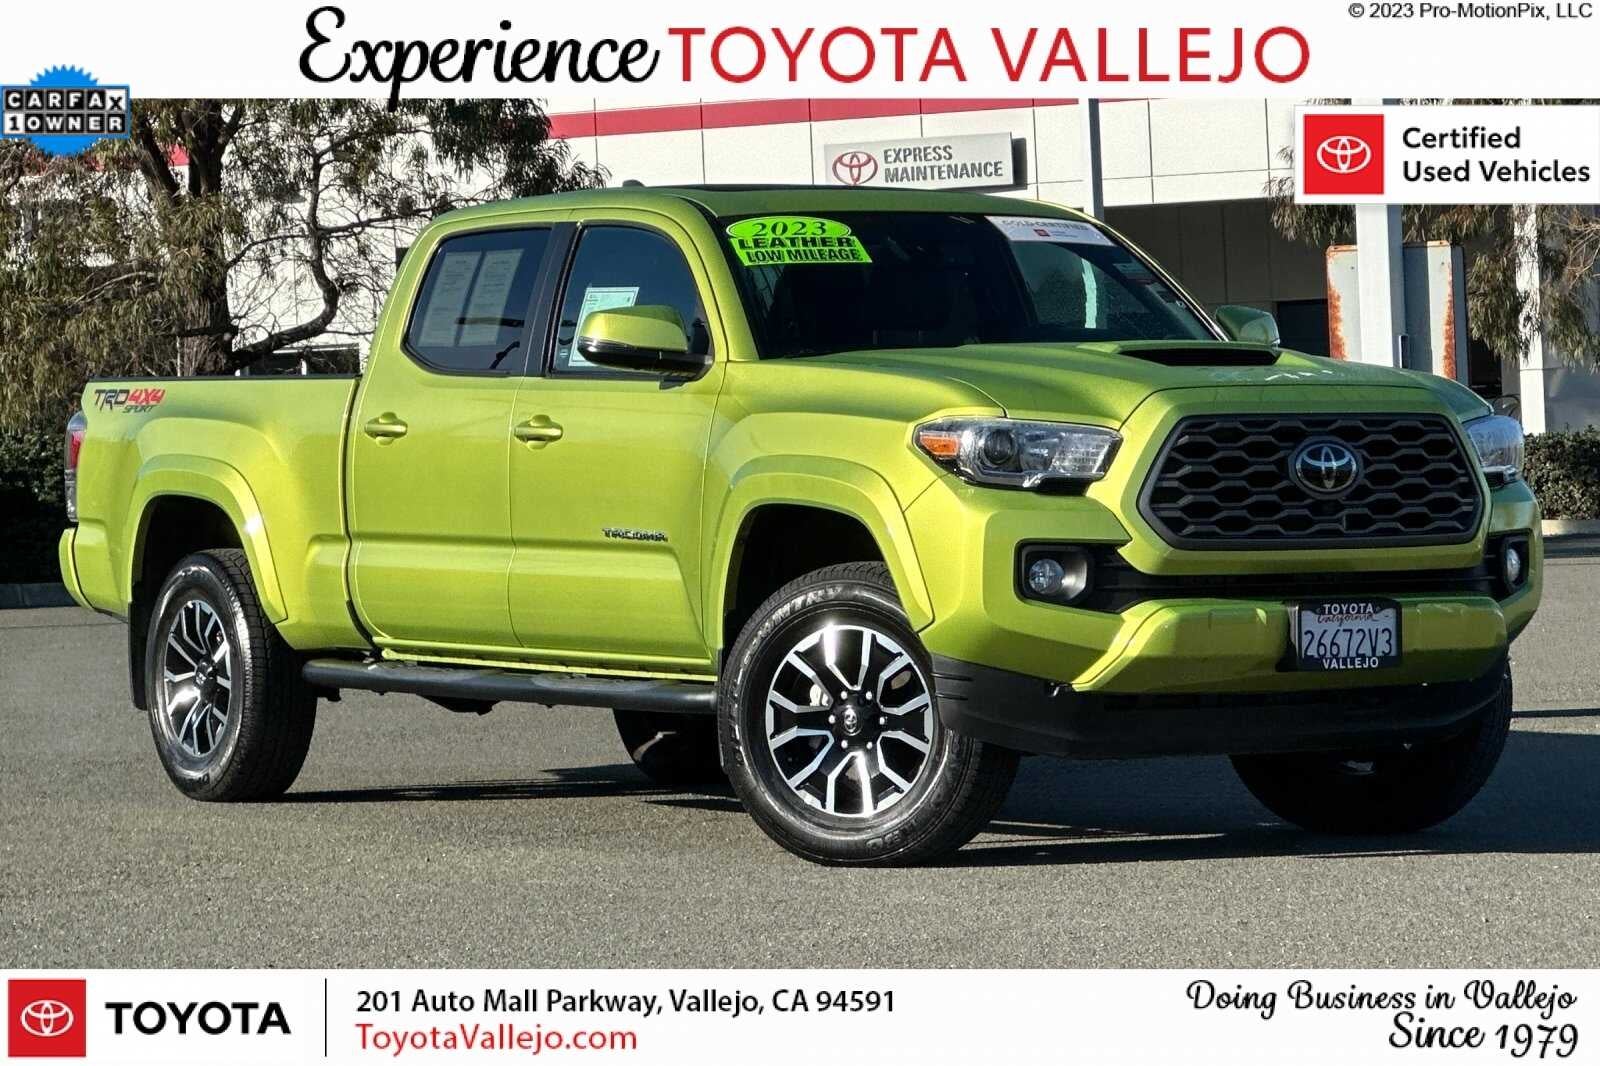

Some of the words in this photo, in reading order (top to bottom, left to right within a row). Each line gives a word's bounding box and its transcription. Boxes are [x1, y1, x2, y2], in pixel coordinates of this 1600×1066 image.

[883, 145, 953, 164] EXPRESS
[884, 161, 1004, 183] MAINTENANCE
[752, 221, 827, 236] 2023
[738, 236, 854, 249] LEATHER
[745, 250, 785, 263] LOW
[785, 248, 864, 262] MILEAGE
[1323, 603, 1374, 615] TOYOTA
[1304, 628, 1392, 657] 26672V3
[1323, 657, 1379, 669] VALLEJO
